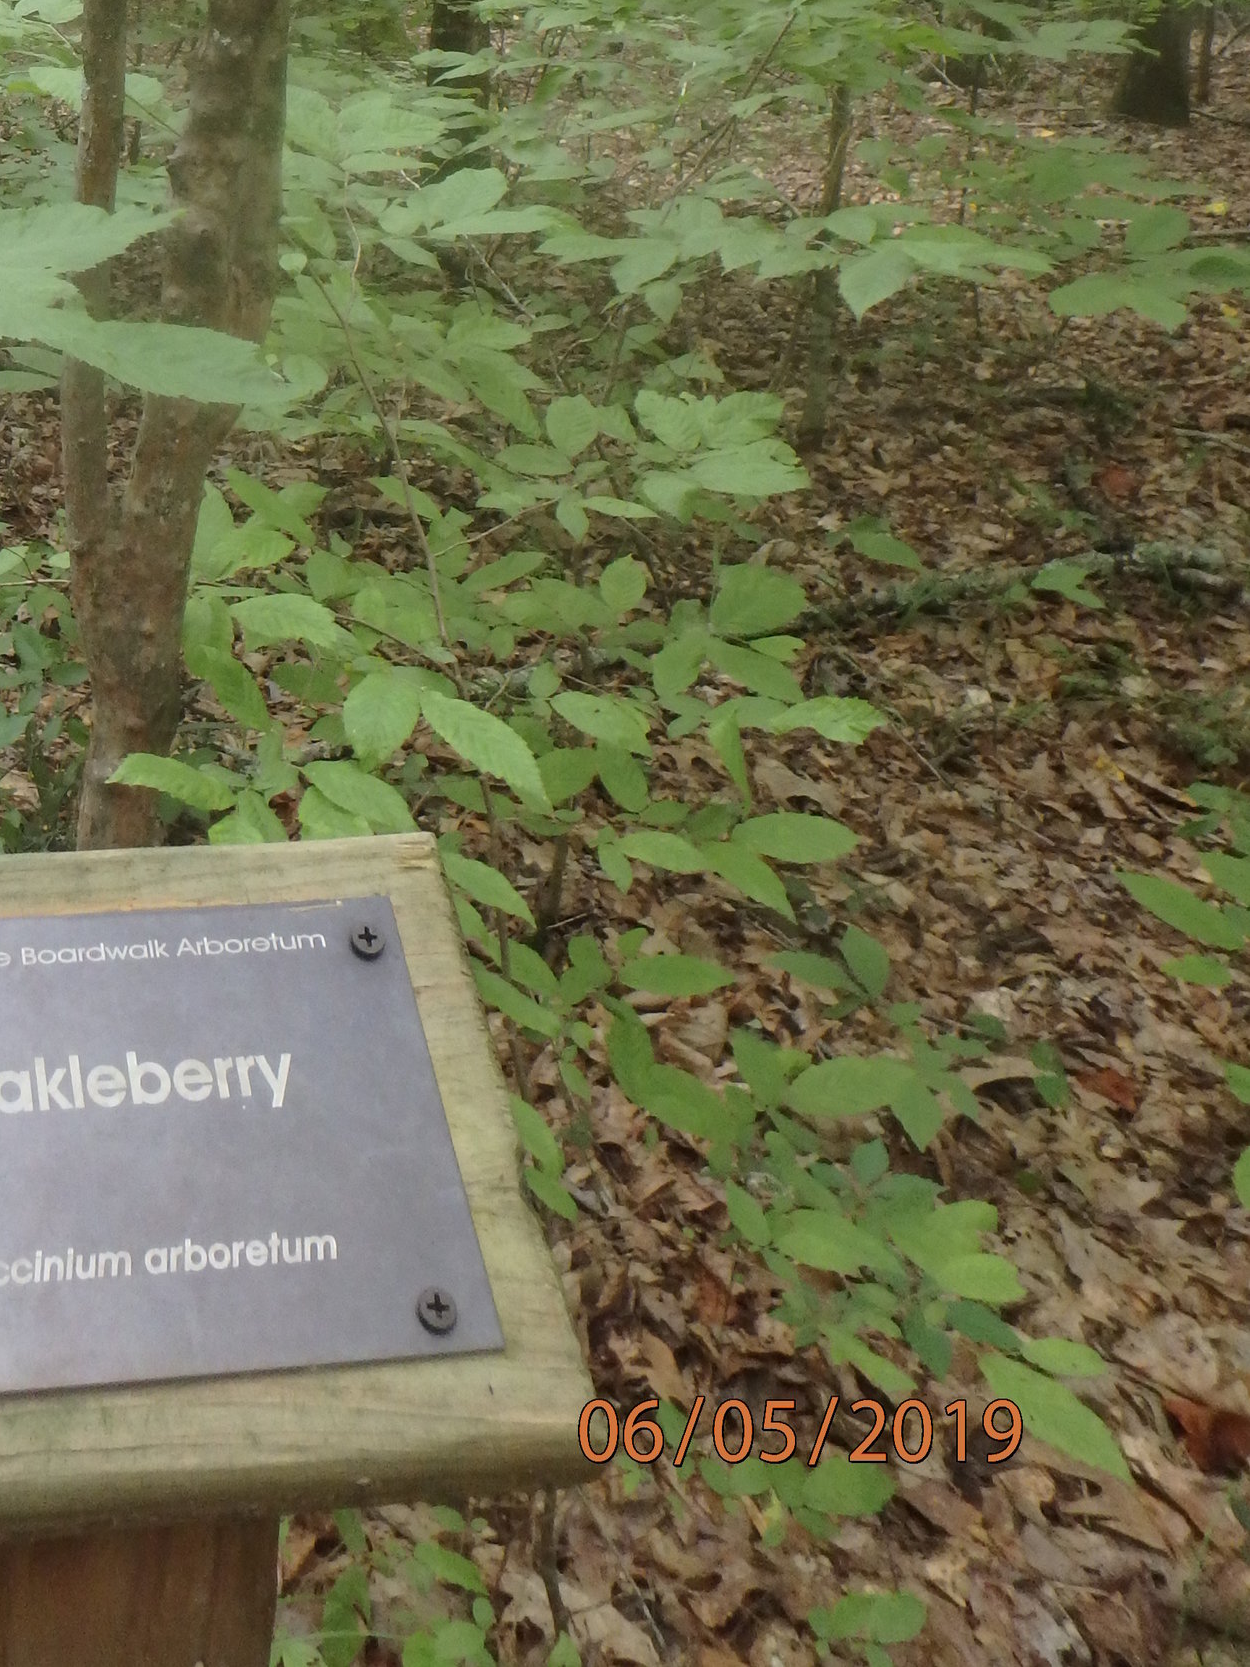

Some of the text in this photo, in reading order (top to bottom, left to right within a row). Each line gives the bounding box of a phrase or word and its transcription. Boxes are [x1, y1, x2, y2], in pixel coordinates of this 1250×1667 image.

[21, 938, 170, 966] Boardwalk
[176, 931, 327, 957] Arboretum
[144, 1231, 338, 1274] arboretum
